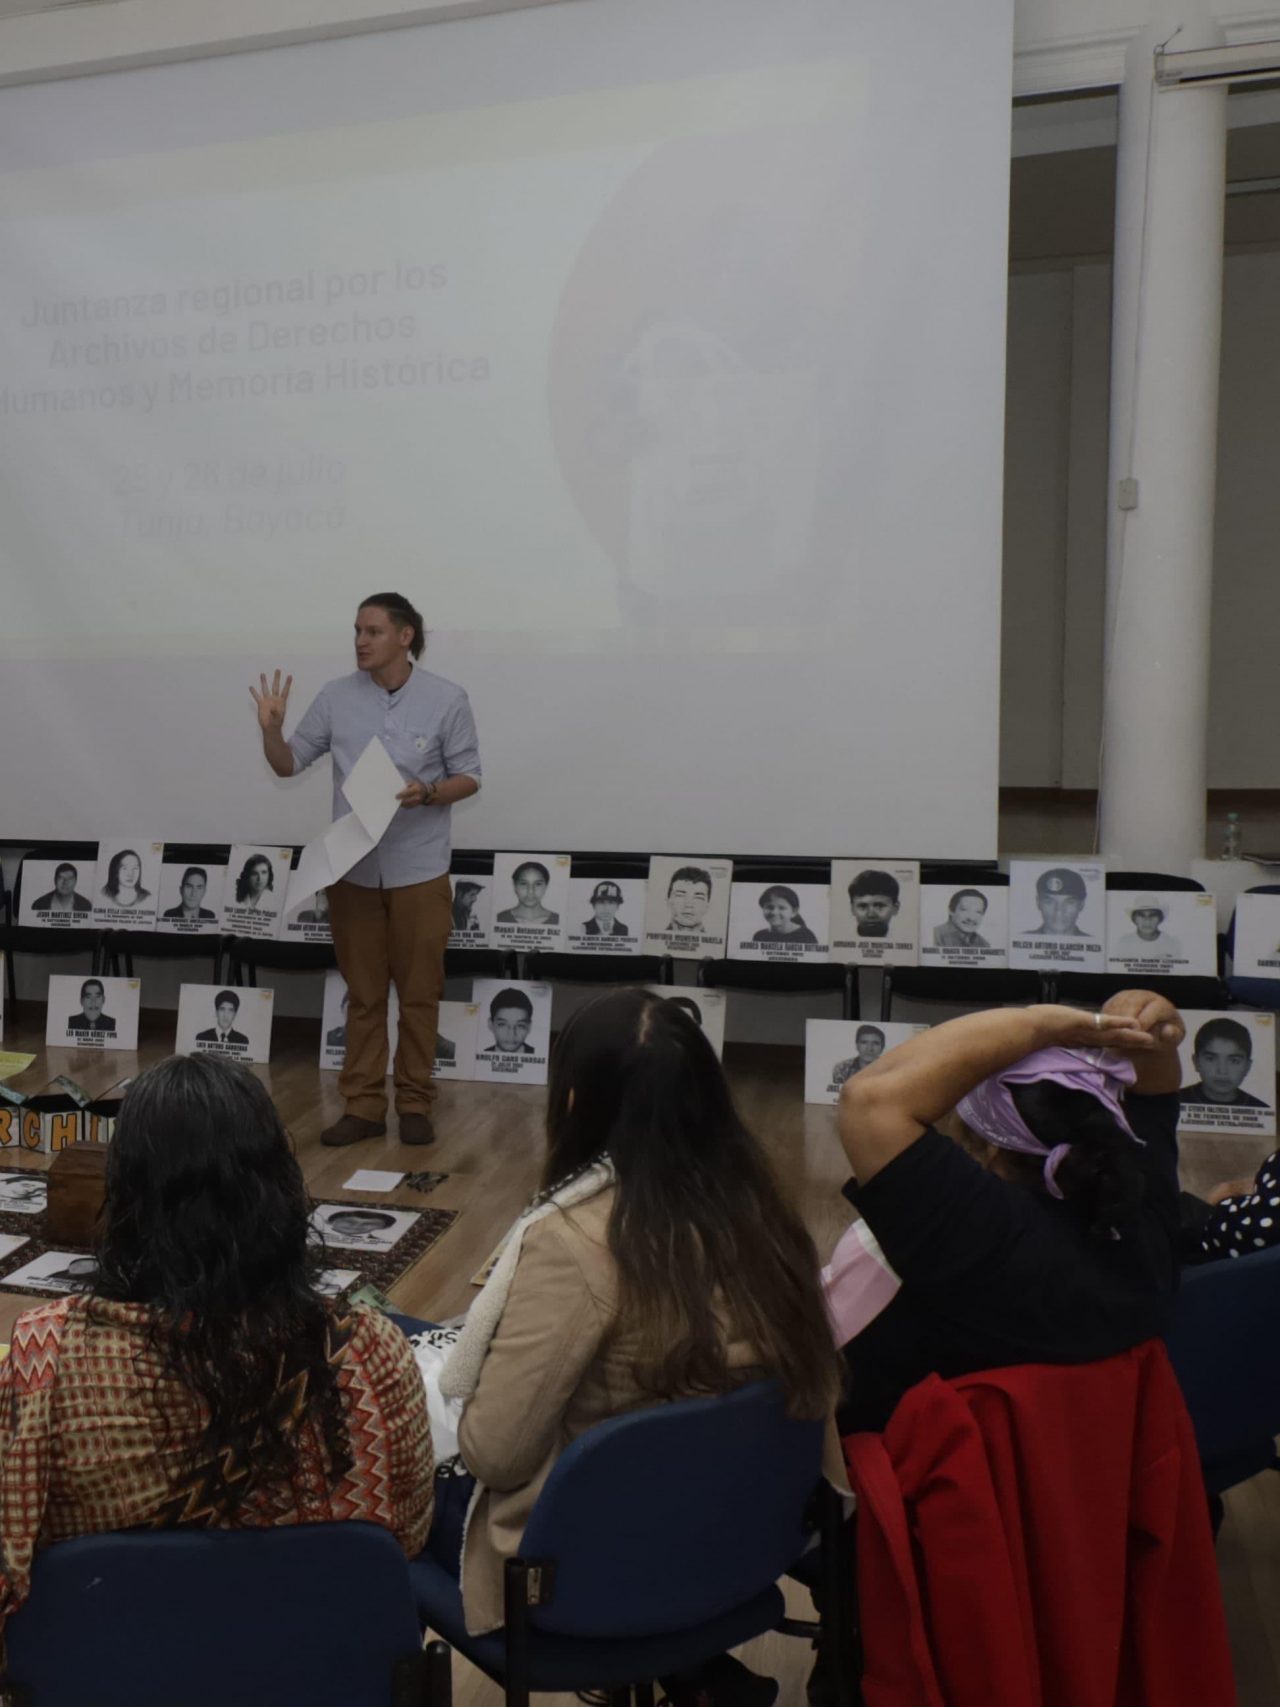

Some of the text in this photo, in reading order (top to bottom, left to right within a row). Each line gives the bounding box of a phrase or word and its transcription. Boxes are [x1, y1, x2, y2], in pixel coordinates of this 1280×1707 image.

[21, 259, 450, 329] Juntanza regional por los
[48, 309, 418, 369] Archivos de Derechos
[140, 378, 161, 413] y
[168, 365, 315, 406] Memoria
[324, 350, 492, 392] Histórica
